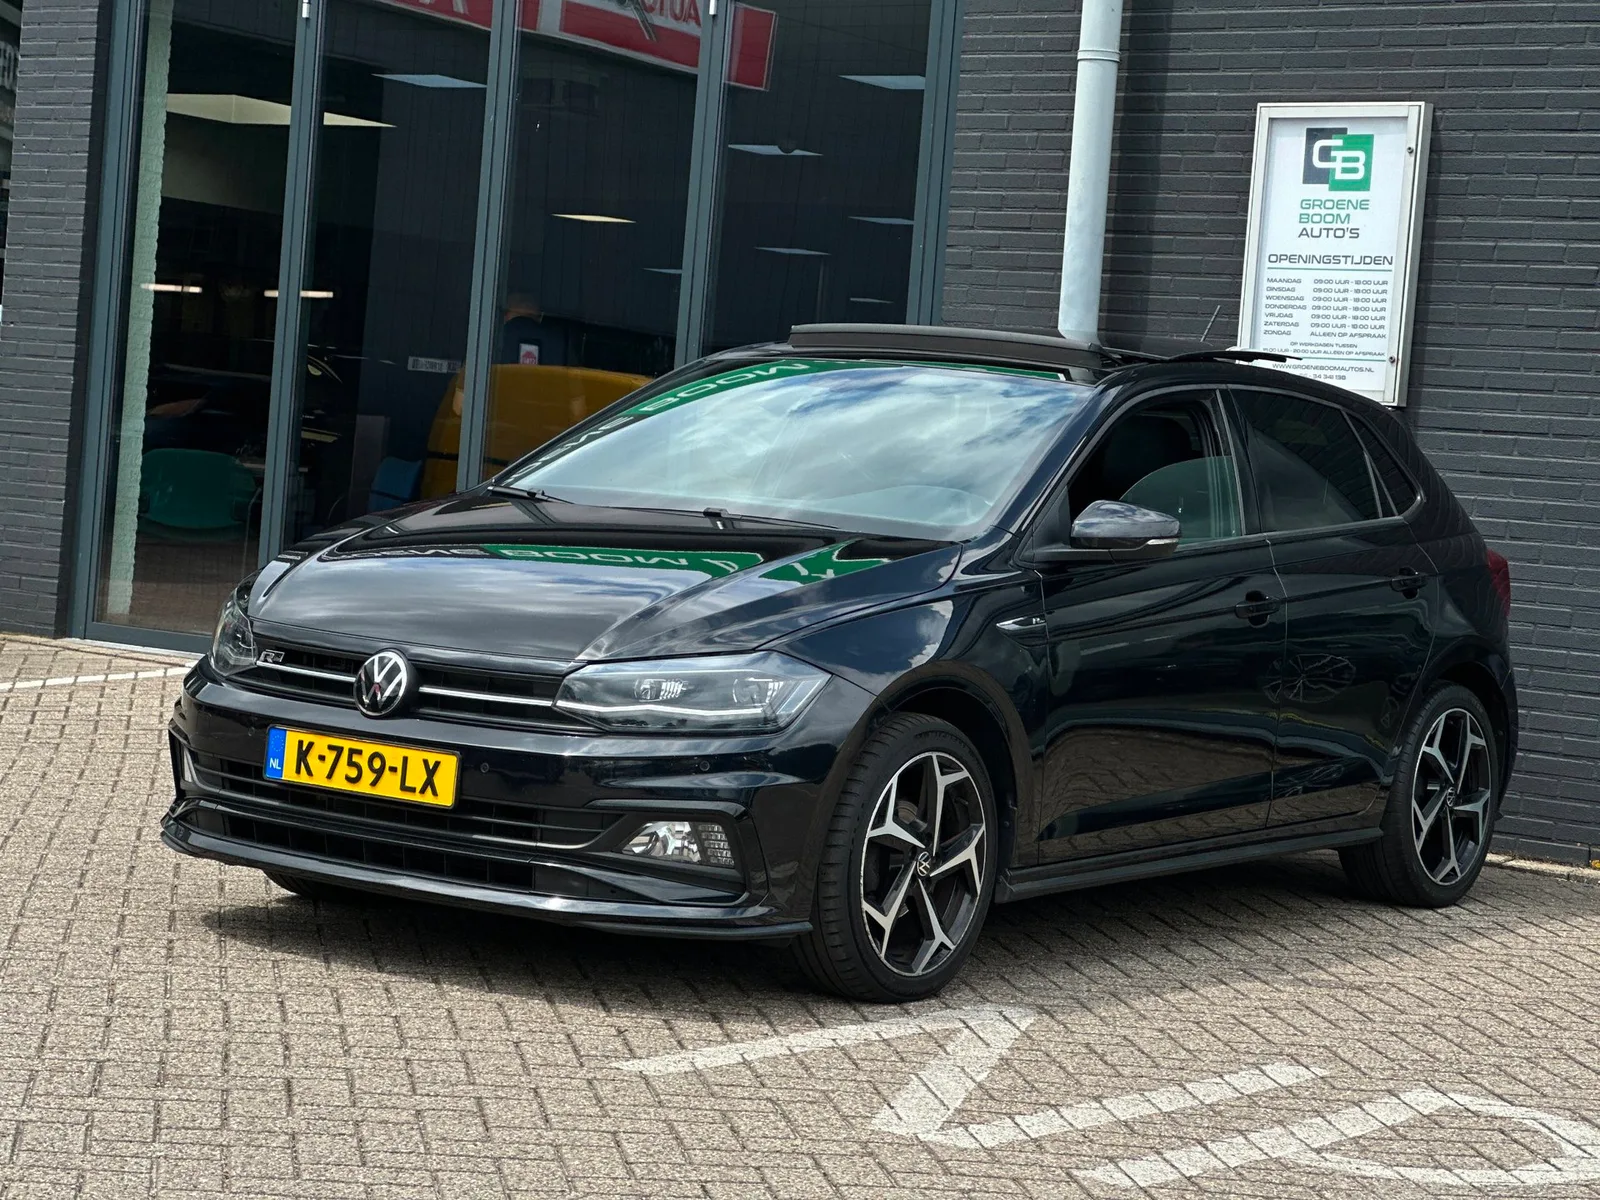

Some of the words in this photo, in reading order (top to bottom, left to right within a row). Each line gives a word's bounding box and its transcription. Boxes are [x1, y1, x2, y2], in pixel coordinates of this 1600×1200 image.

[1300, 199, 1370, 210] GROENE
[1299, 213, 1351, 224] BOOM
[1298, 227, 1360, 239] AUTO'S
[1268, 253, 1393, 266] OPENINGSTIJDEN
[269, 757, 282, 770] NL
[294, 739, 442, 797] K-759-LX
